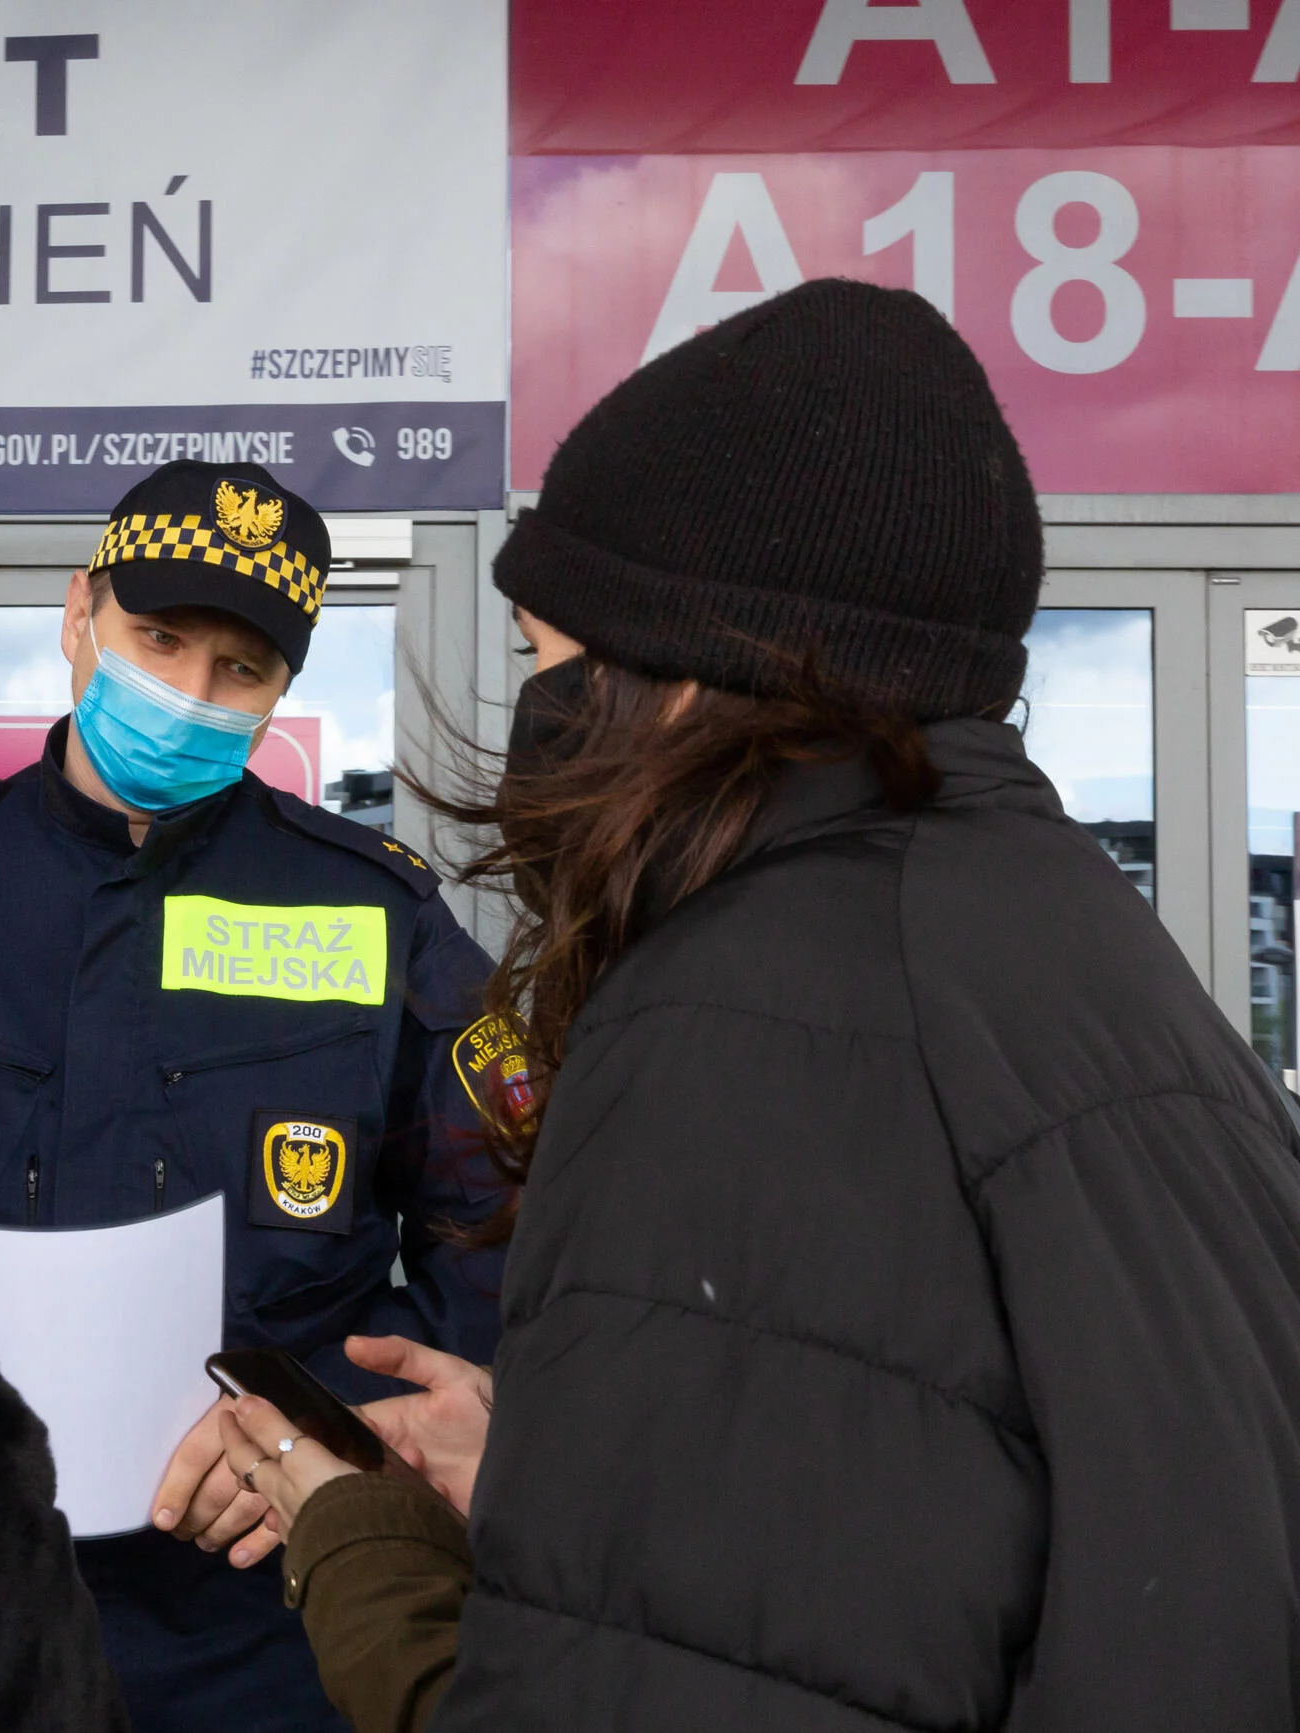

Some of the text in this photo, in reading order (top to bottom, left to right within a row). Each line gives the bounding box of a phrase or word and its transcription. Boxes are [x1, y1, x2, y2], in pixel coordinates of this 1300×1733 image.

[638, 170, 1300, 375] A18-
[250, 345, 453, 383] #SZCZEPIMYSIĘ
[396, 427, 453, 460] 989
[205, 914, 354, 953] STRAŻ
[181, 947, 372, 994] MIEJSKA
[469, 1017, 508, 1049] STRA
[467, 1032, 528, 1073] MIEJSK
[292, 1125, 322, 1139] 200
[282, 1198, 322, 1215] KRAKÓW
